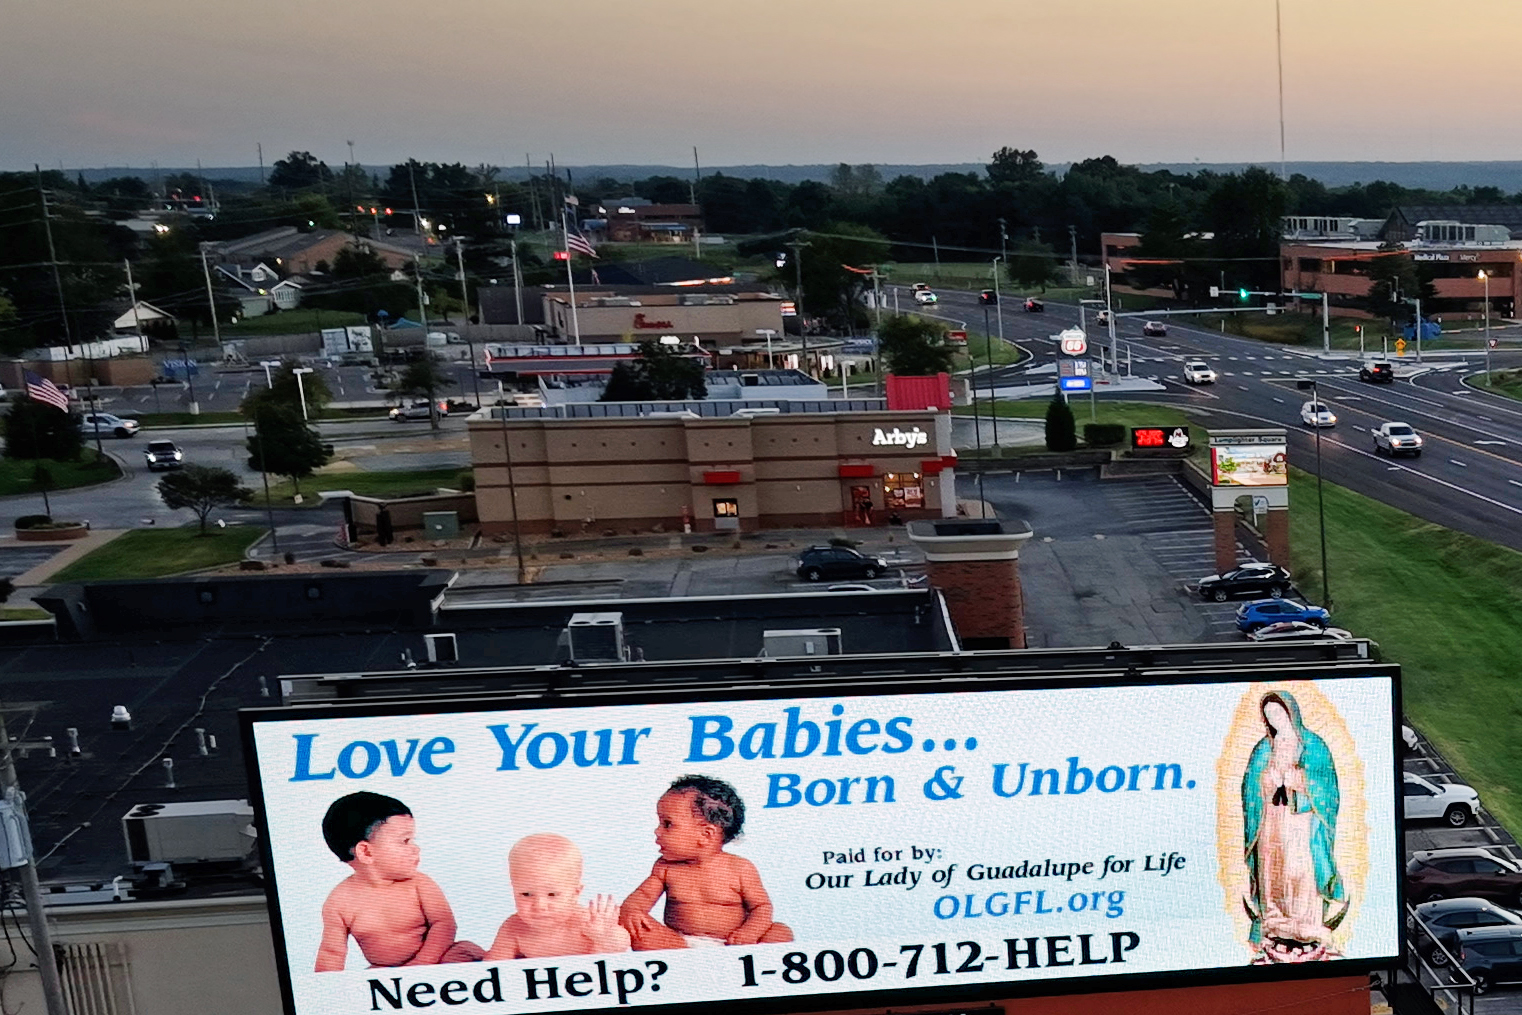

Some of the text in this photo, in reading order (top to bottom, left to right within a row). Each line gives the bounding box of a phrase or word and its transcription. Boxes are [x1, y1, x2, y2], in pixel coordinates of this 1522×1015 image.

[1066, 340, 1082, 351] 66
[872, 426, 928, 449] Arby's
[289, 703, 979, 782] Love Your Babies...
[763, 757, 1197, 809] Born & Unborn.
[805, 851, 1187, 890] Our Lady of Guadalupe for Life
[822, 846, 943, 865] Paid for by:
[933, 889, 1127, 920] OLGFL.org
[367, 931, 1141, 1011] Need Help? 1-800-712-HELP
